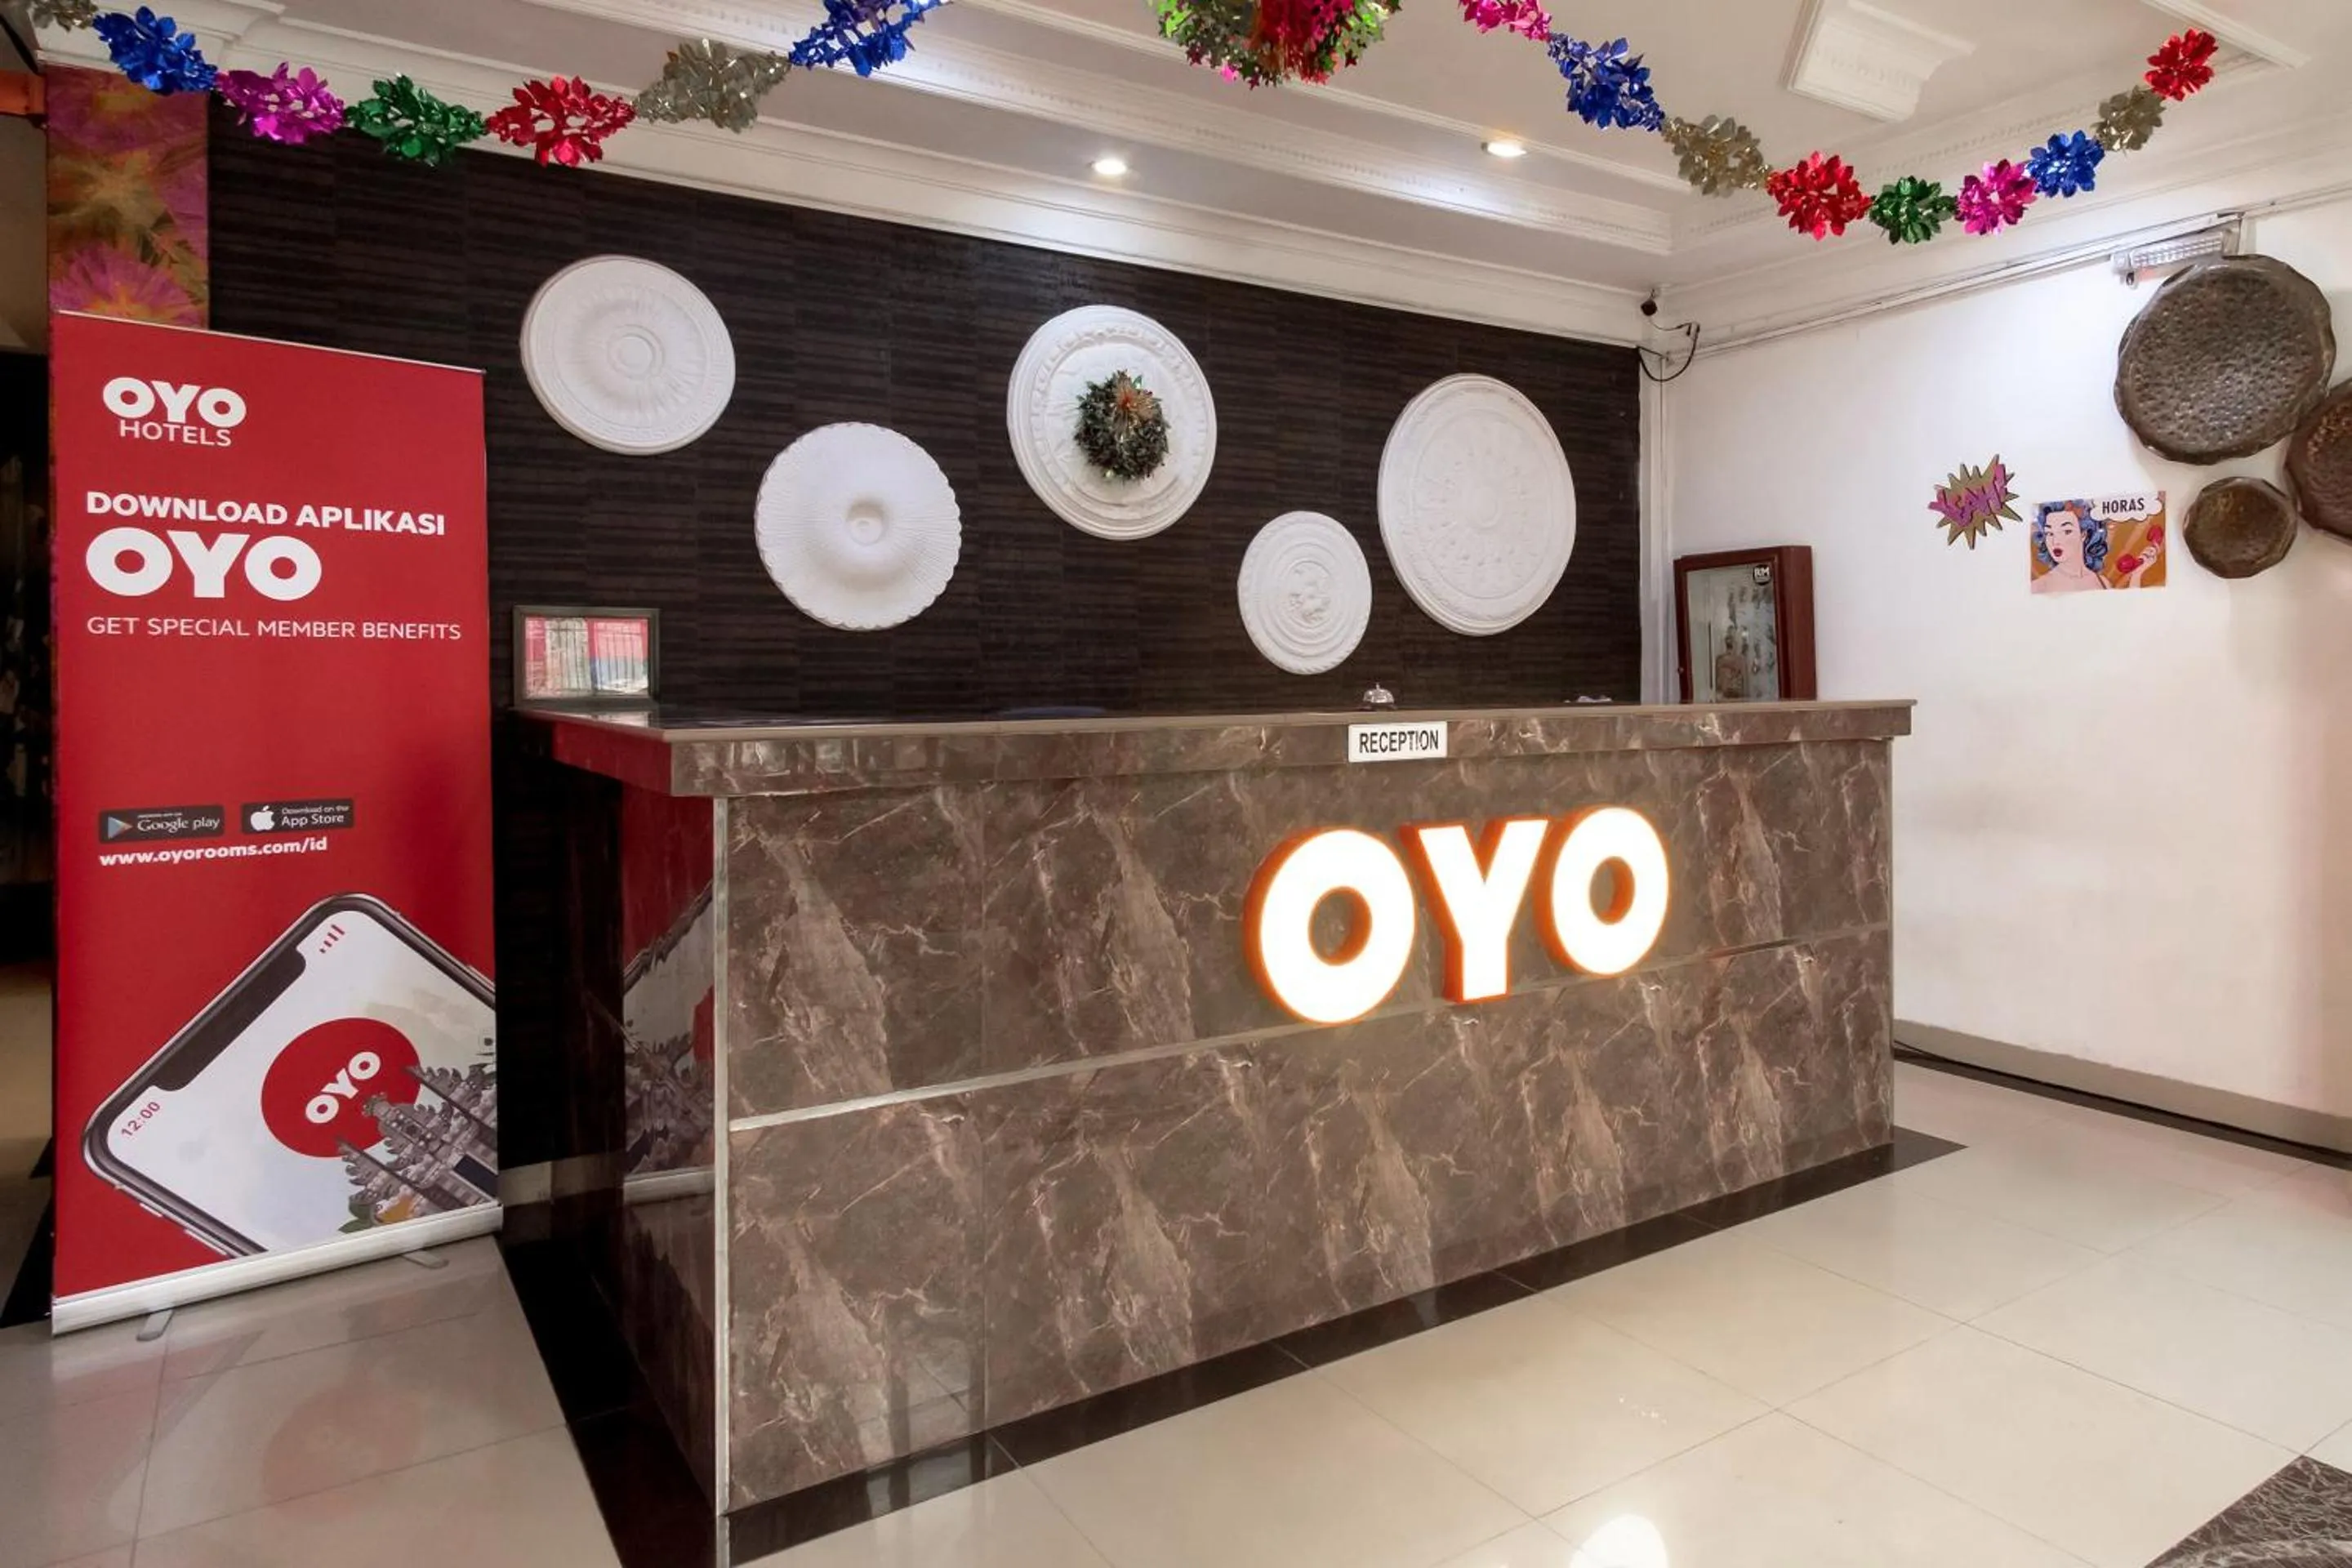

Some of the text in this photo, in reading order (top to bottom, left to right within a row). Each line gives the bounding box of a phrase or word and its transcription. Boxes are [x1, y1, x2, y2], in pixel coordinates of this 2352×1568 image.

[103, 376, 247, 428] OYO
[120, 419, 231, 447] HOTELS
[87, 491, 445, 536] DOWNLOAD APLIKASI
[2102, 497, 2145, 514] HORAS
[86, 527, 322, 601] OYO
[87, 617, 461, 640] GET SPECIAL MEMBER BENEFITS
[1360, 729, 1439, 754] RECEPTION
[137, 816, 220, 833] Google play
[282, 813, 344, 828] App Store
[100, 835, 327, 866] www.oyorooms.com/id
[1243, 805, 1669, 1026] OYO
[305, 1051, 381, 1124] OYO
[121, 1102, 161, 1136] 12:00
